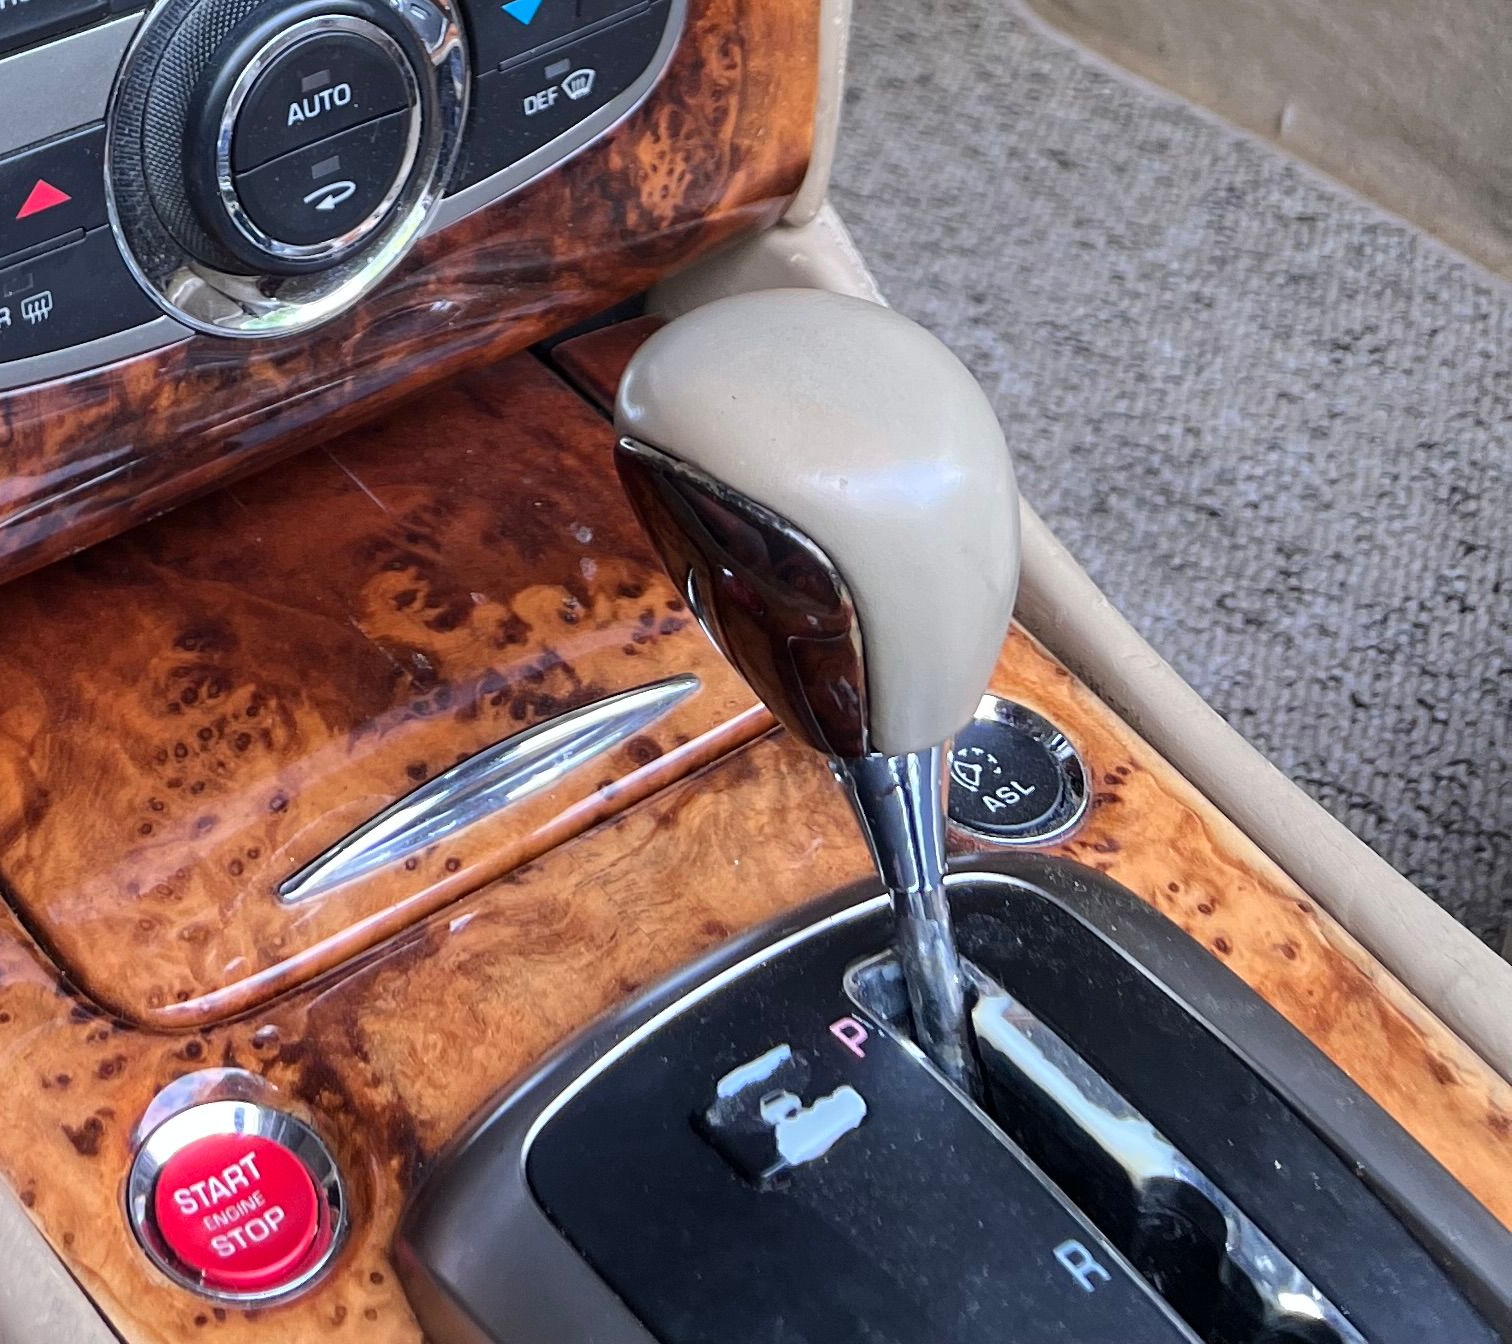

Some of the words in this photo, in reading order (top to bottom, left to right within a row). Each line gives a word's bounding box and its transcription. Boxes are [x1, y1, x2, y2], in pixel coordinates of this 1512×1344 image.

[286, 83, 352, 127] AUTO
[523, 86, 559, 116] DEF
[981, 780, 1036, 813] ASL
[829, 1016, 869, 1058] P
[172, 1151, 263, 1216] START
[202, 1189, 266, 1232] ENGINE
[210, 1205, 286, 1258] STOP
[1052, 1239, 1112, 1293] R
